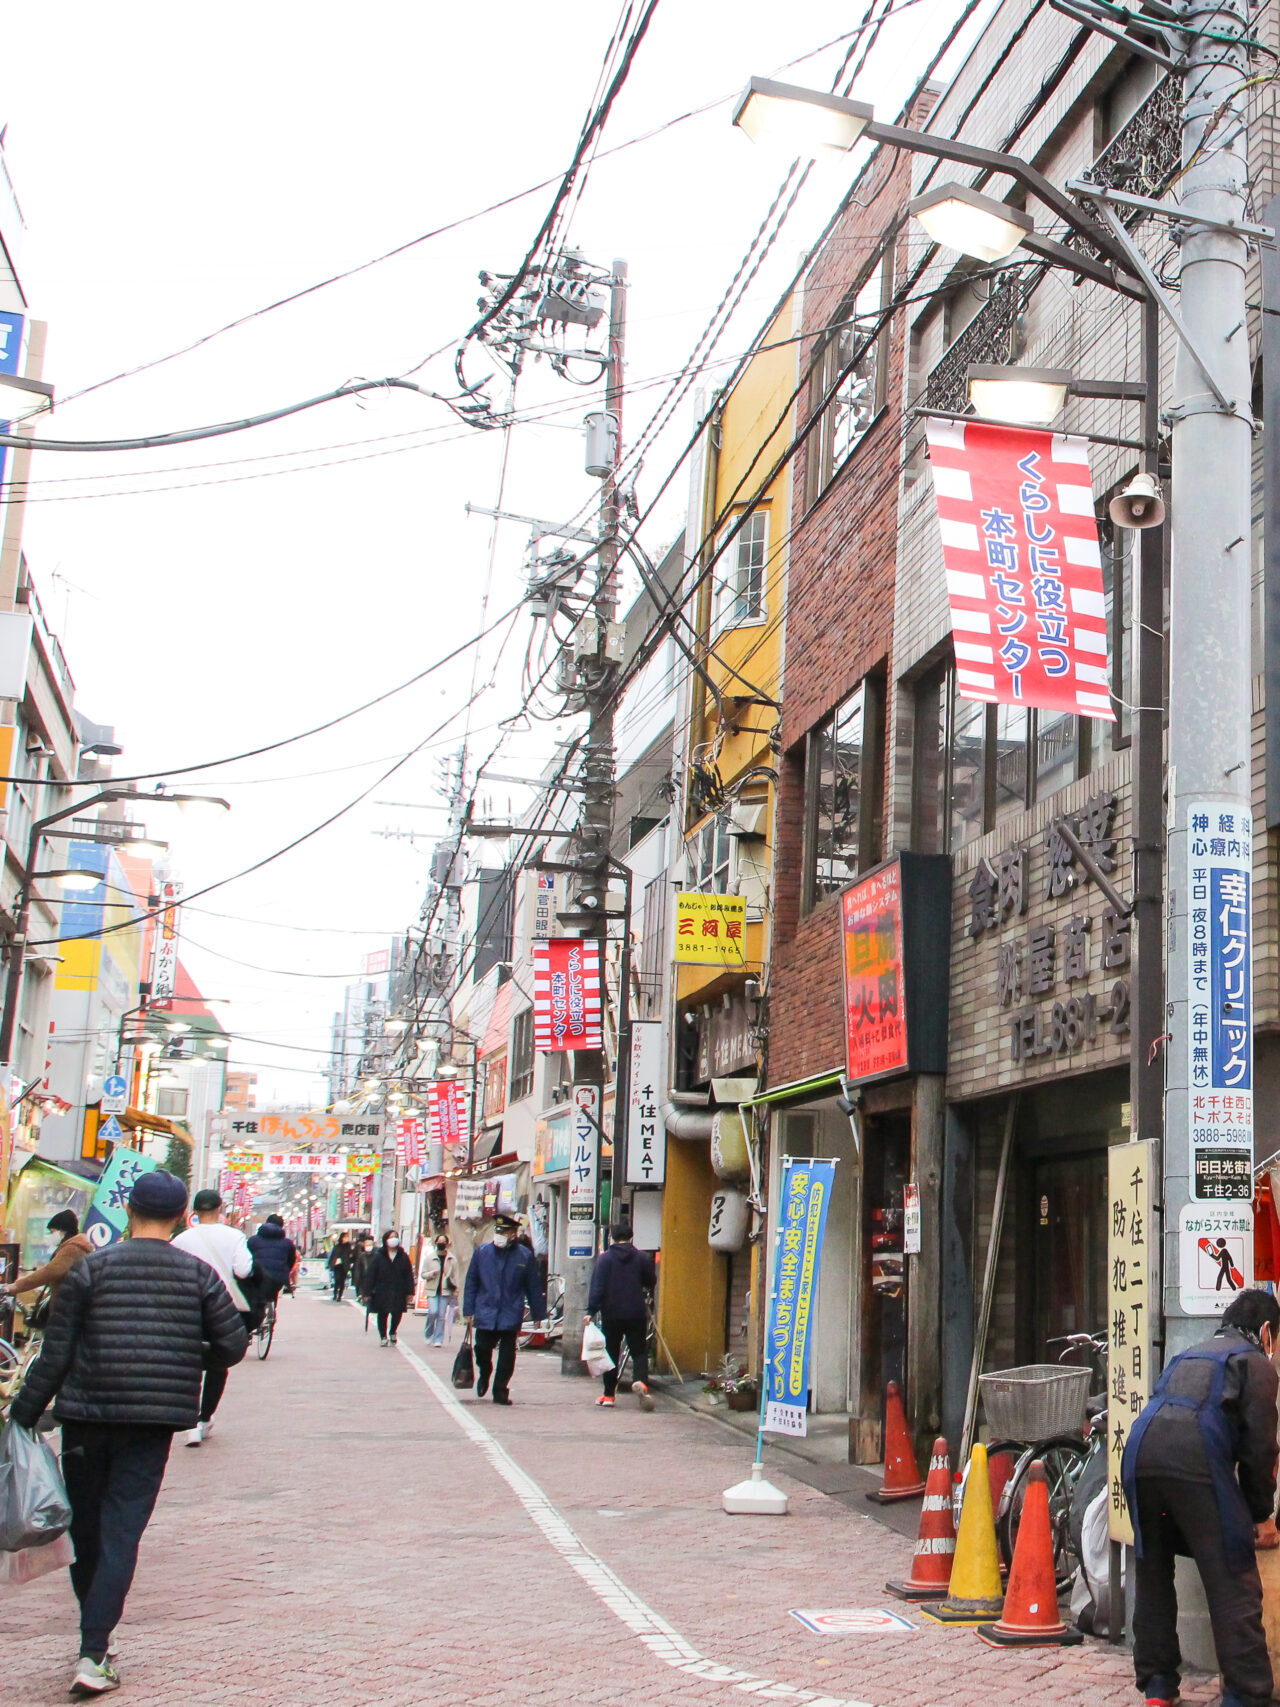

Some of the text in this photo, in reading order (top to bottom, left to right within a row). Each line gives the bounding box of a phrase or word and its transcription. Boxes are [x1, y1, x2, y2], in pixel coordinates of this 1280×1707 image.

[980, 507, 1031, 700] 本町センター
[1017, 450, 1069, 677] くらしに役立つ
[678, 917, 742, 939] 三河屋
[551, 972, 568, 1047] 本町センター
[567, 946, 584, 1037] くらしに役立つ
[1218, 873, 1248, 1086] 幸仁クリニック
[1193, 1095, 1251, 1110] 北千住西口
[574, 1125, 592, 1182] マルヤ
[710, 1196, 726, 1237] ワイン
[1185, 1218, 1251, 1232] ながらスマホ禁止
[773, 1171, 810, 1401] 安心・安全まちづくり
[1111, 1198, 1128, 1521] 防犯推進本部
